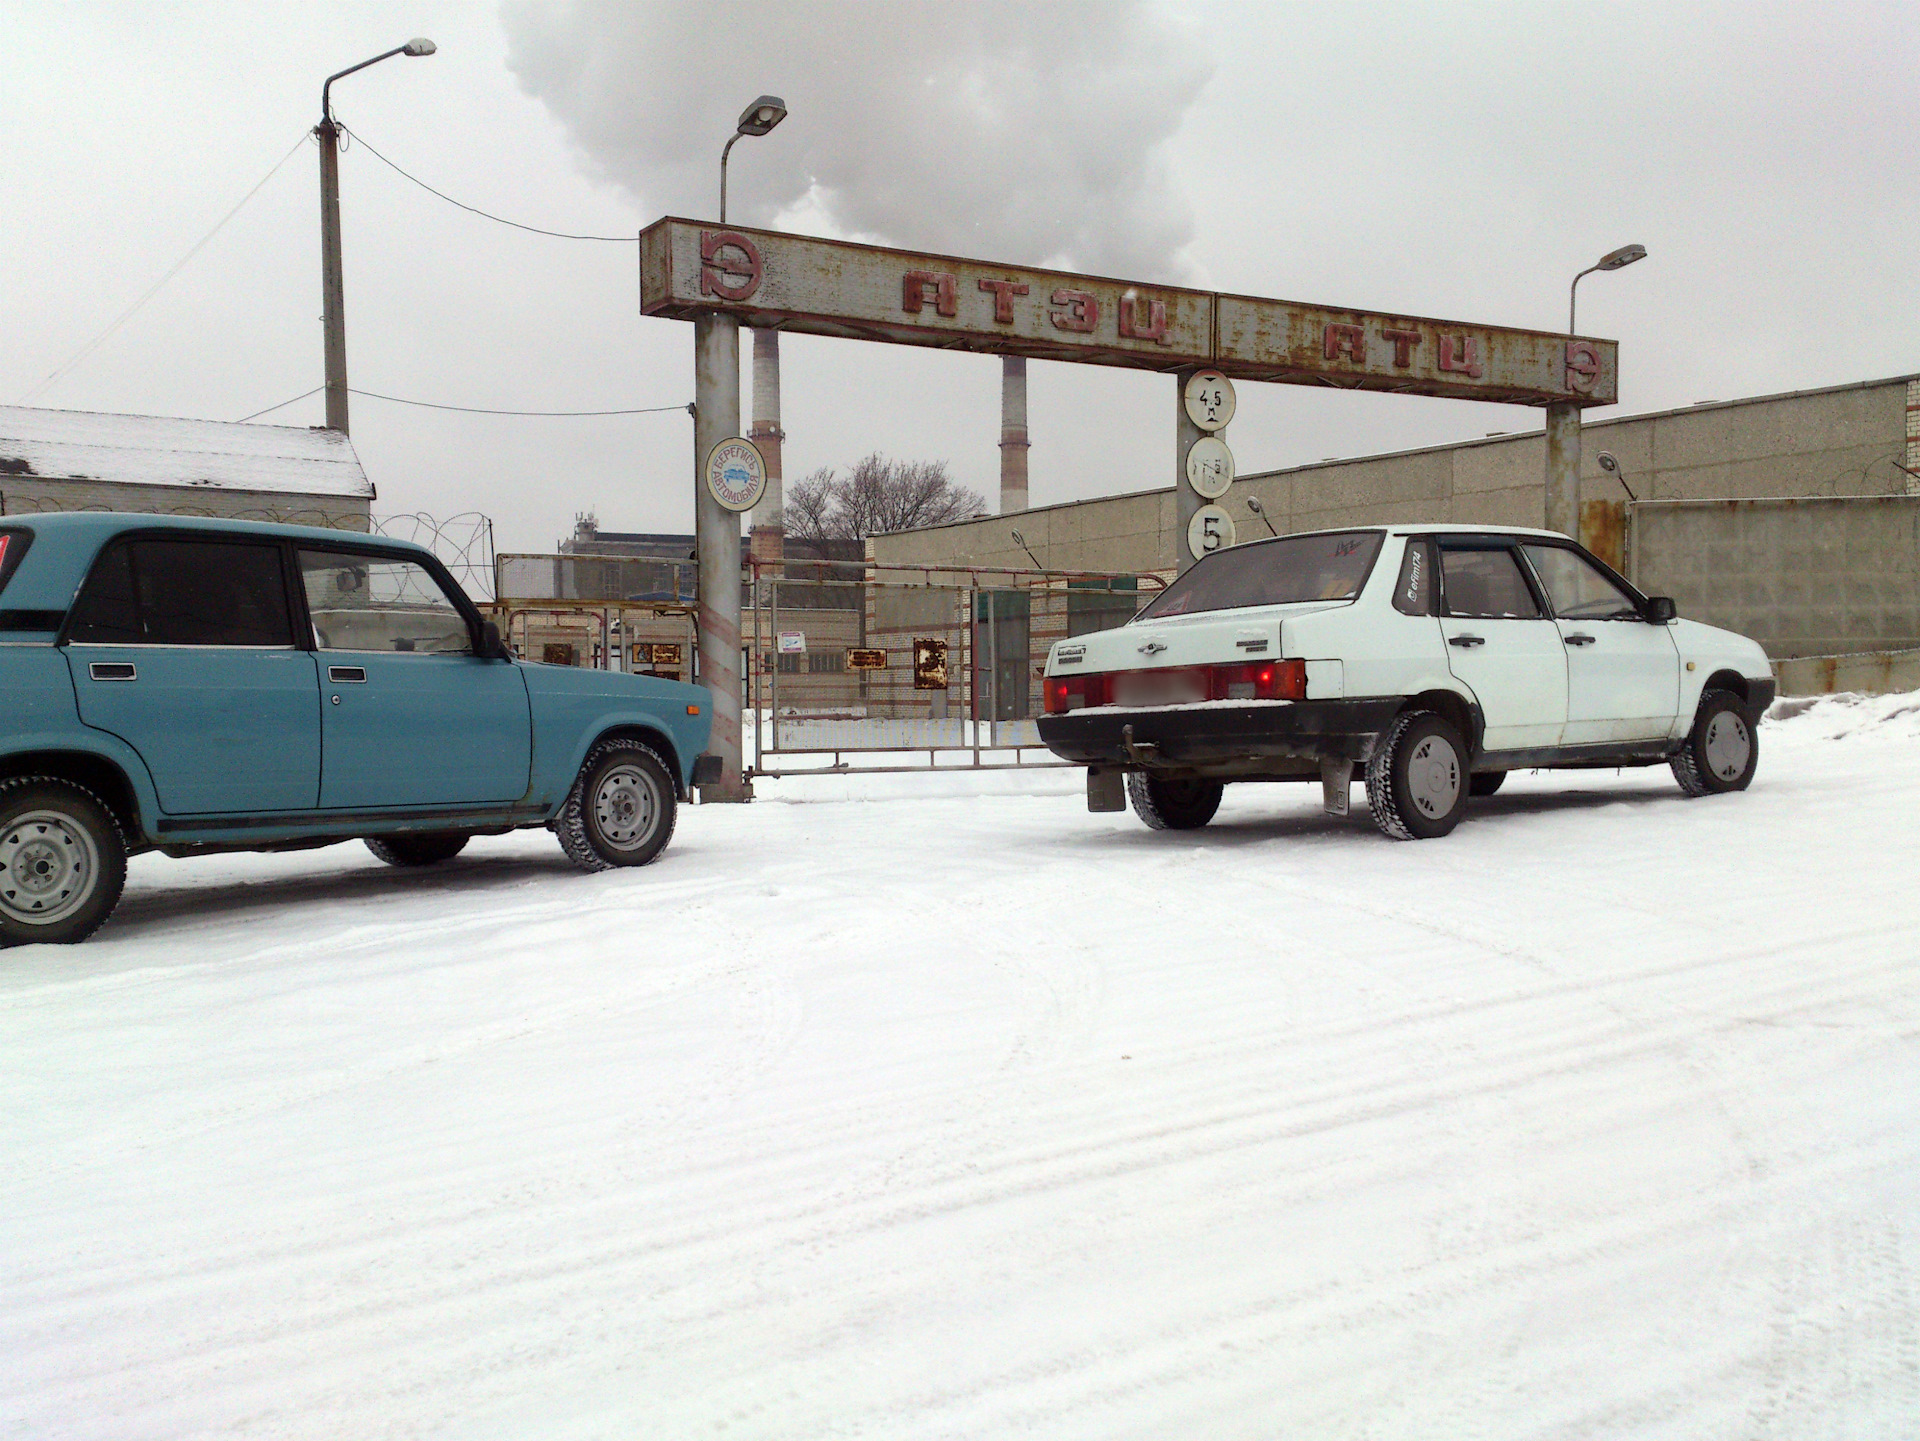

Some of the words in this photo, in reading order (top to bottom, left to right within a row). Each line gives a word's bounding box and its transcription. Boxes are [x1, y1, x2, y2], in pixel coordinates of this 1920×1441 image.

[903, 269, 1172, 346] АТЭЦ
[1324, 321, 1482, 378] АТЦ
[714, 446, 756, 470] БЕРЕГИСЬ
[712, 470, 759, 503] АВТОМОБИЛЯ
[1203, 517, 1221, 551] 5
